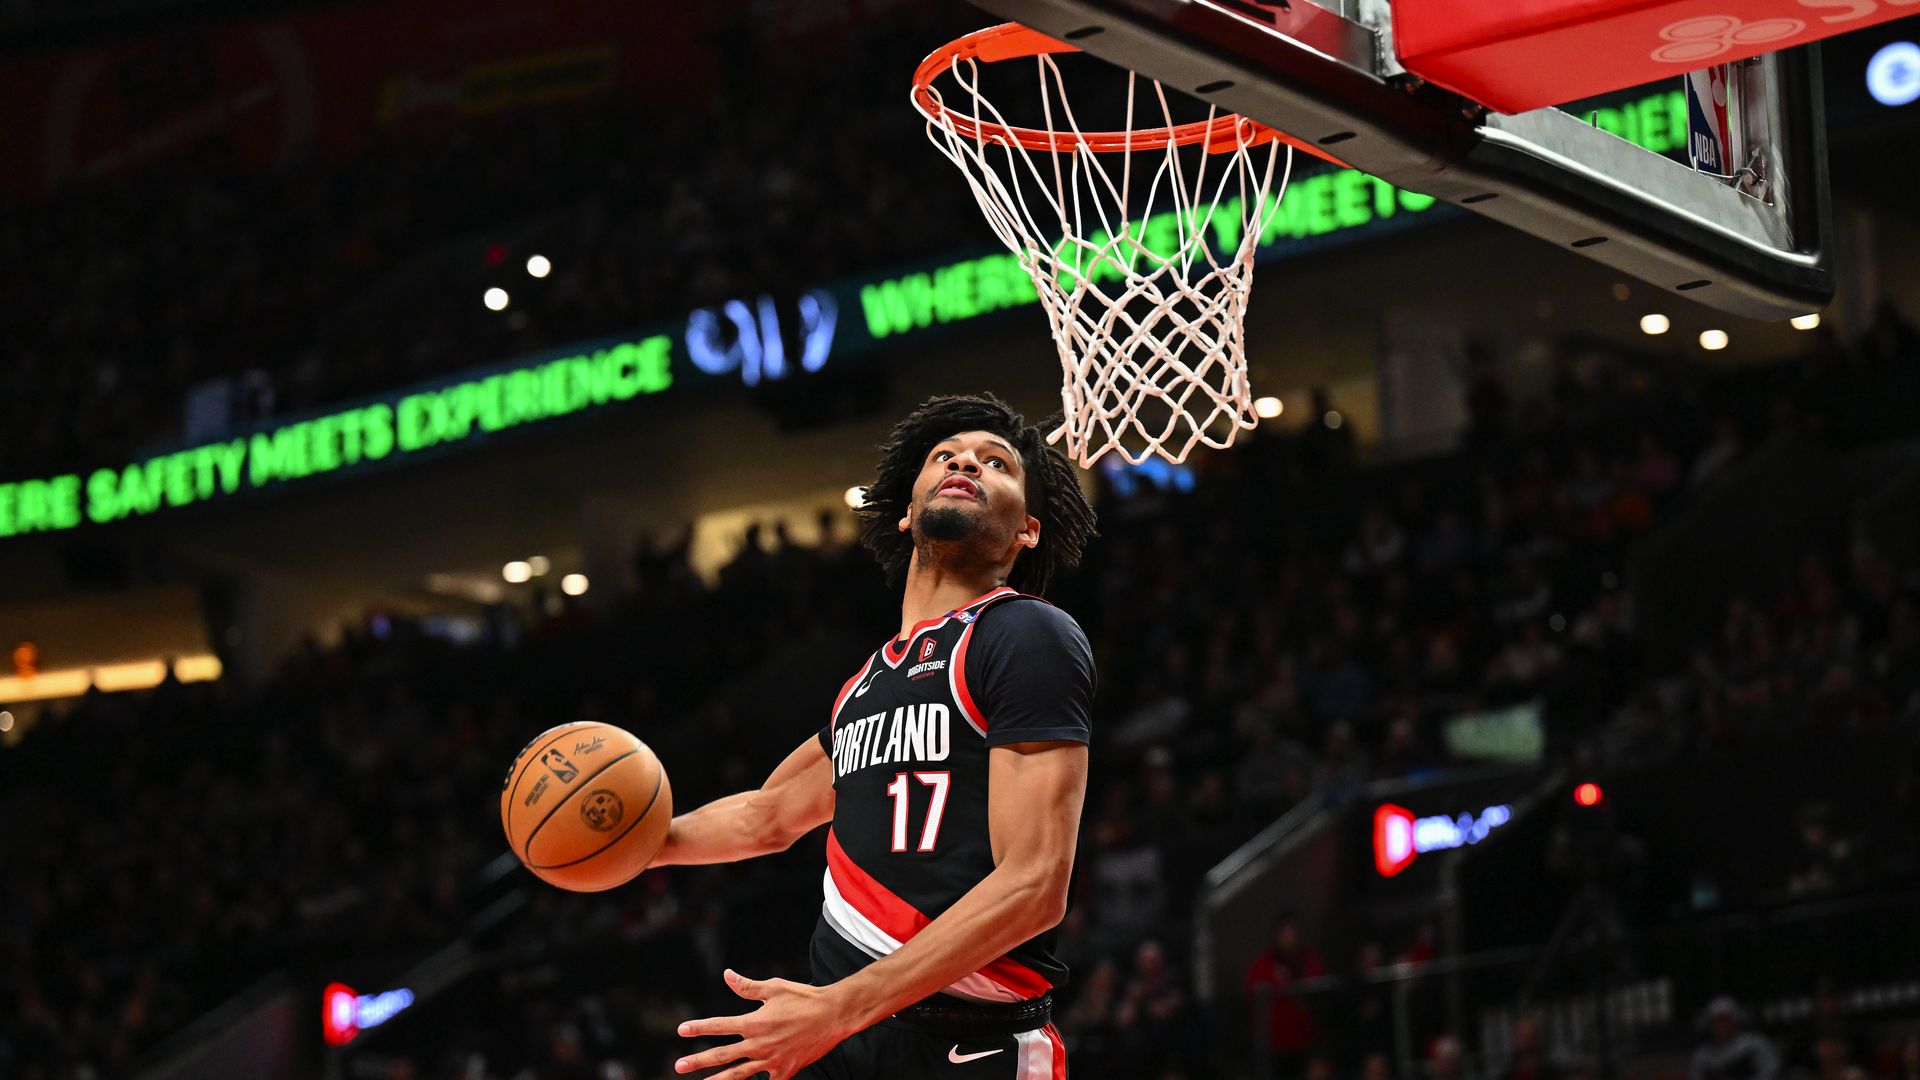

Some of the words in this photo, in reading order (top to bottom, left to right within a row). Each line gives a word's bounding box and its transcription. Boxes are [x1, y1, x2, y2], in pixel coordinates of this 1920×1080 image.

[1694, 131, 1717, 168] NBA
[860, 246, 1039, 338] WHERE
[1051, 196, 1246, 293] SAFETY
[87, 438, 248, 523] SAFETY
[249, 402, 395, 486] MEETS
[396, 334, 673, 451] EXPERIENCE
[832, 702, 950, 778] PORTLAND
[887, 770, 951, 853] 17
